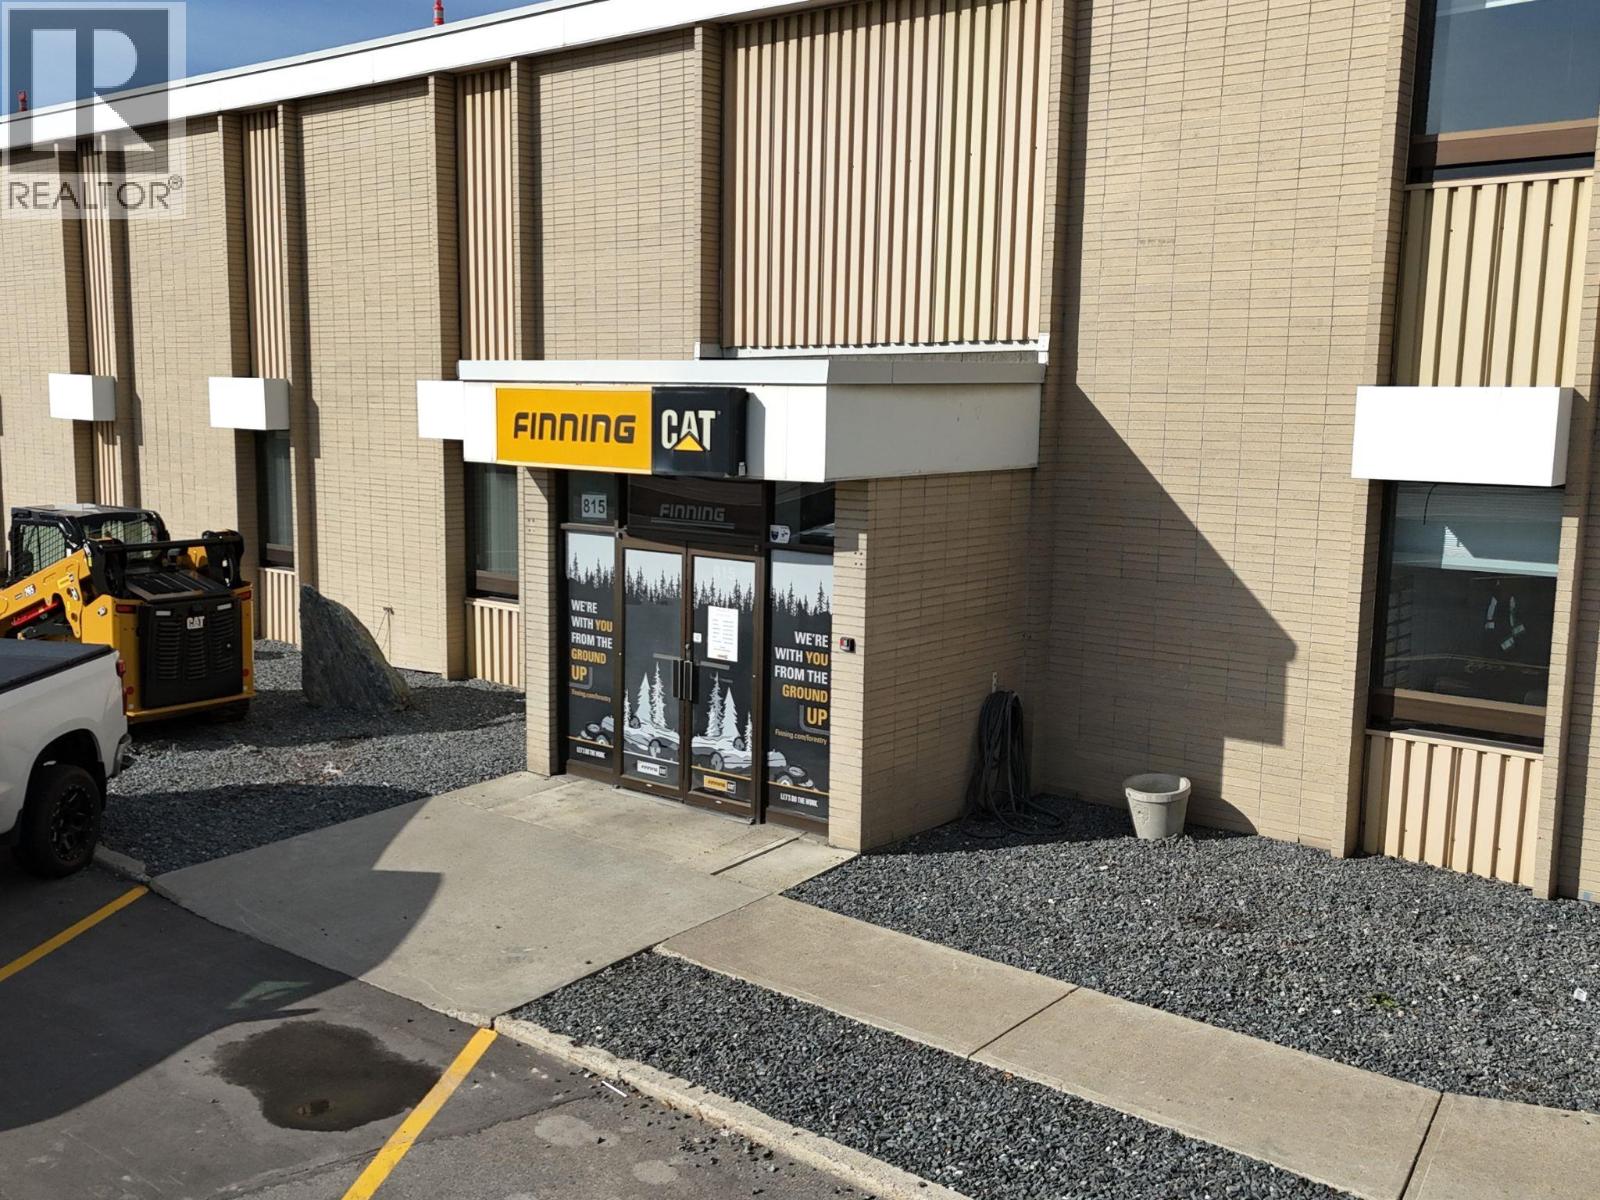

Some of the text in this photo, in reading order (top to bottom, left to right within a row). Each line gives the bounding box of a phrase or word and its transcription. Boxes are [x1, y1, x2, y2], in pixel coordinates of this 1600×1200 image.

[513, 409, 716, 451] FINNING CAT
[583, 499, 605, 514] 815
[659, 503, 725, 522] FINNING
[570, 599, 598, 614] WE'RE
[186, 616, 205, 630] CAT
[570, 615, 613, 633] WITH YOU
[570, 632, 613, 649] FROM THE
[794, 630, 829, 648] WE'RE
[570, 648, 607, 665] GROUND
[774, 646, 828, 666] WITH YOU
[571, 664, 588, 681] UP
[774, 665, 828, 685] FROM THE
[782, 684, 828, 703] GROUND
[806, 706, 828, 726] UP
